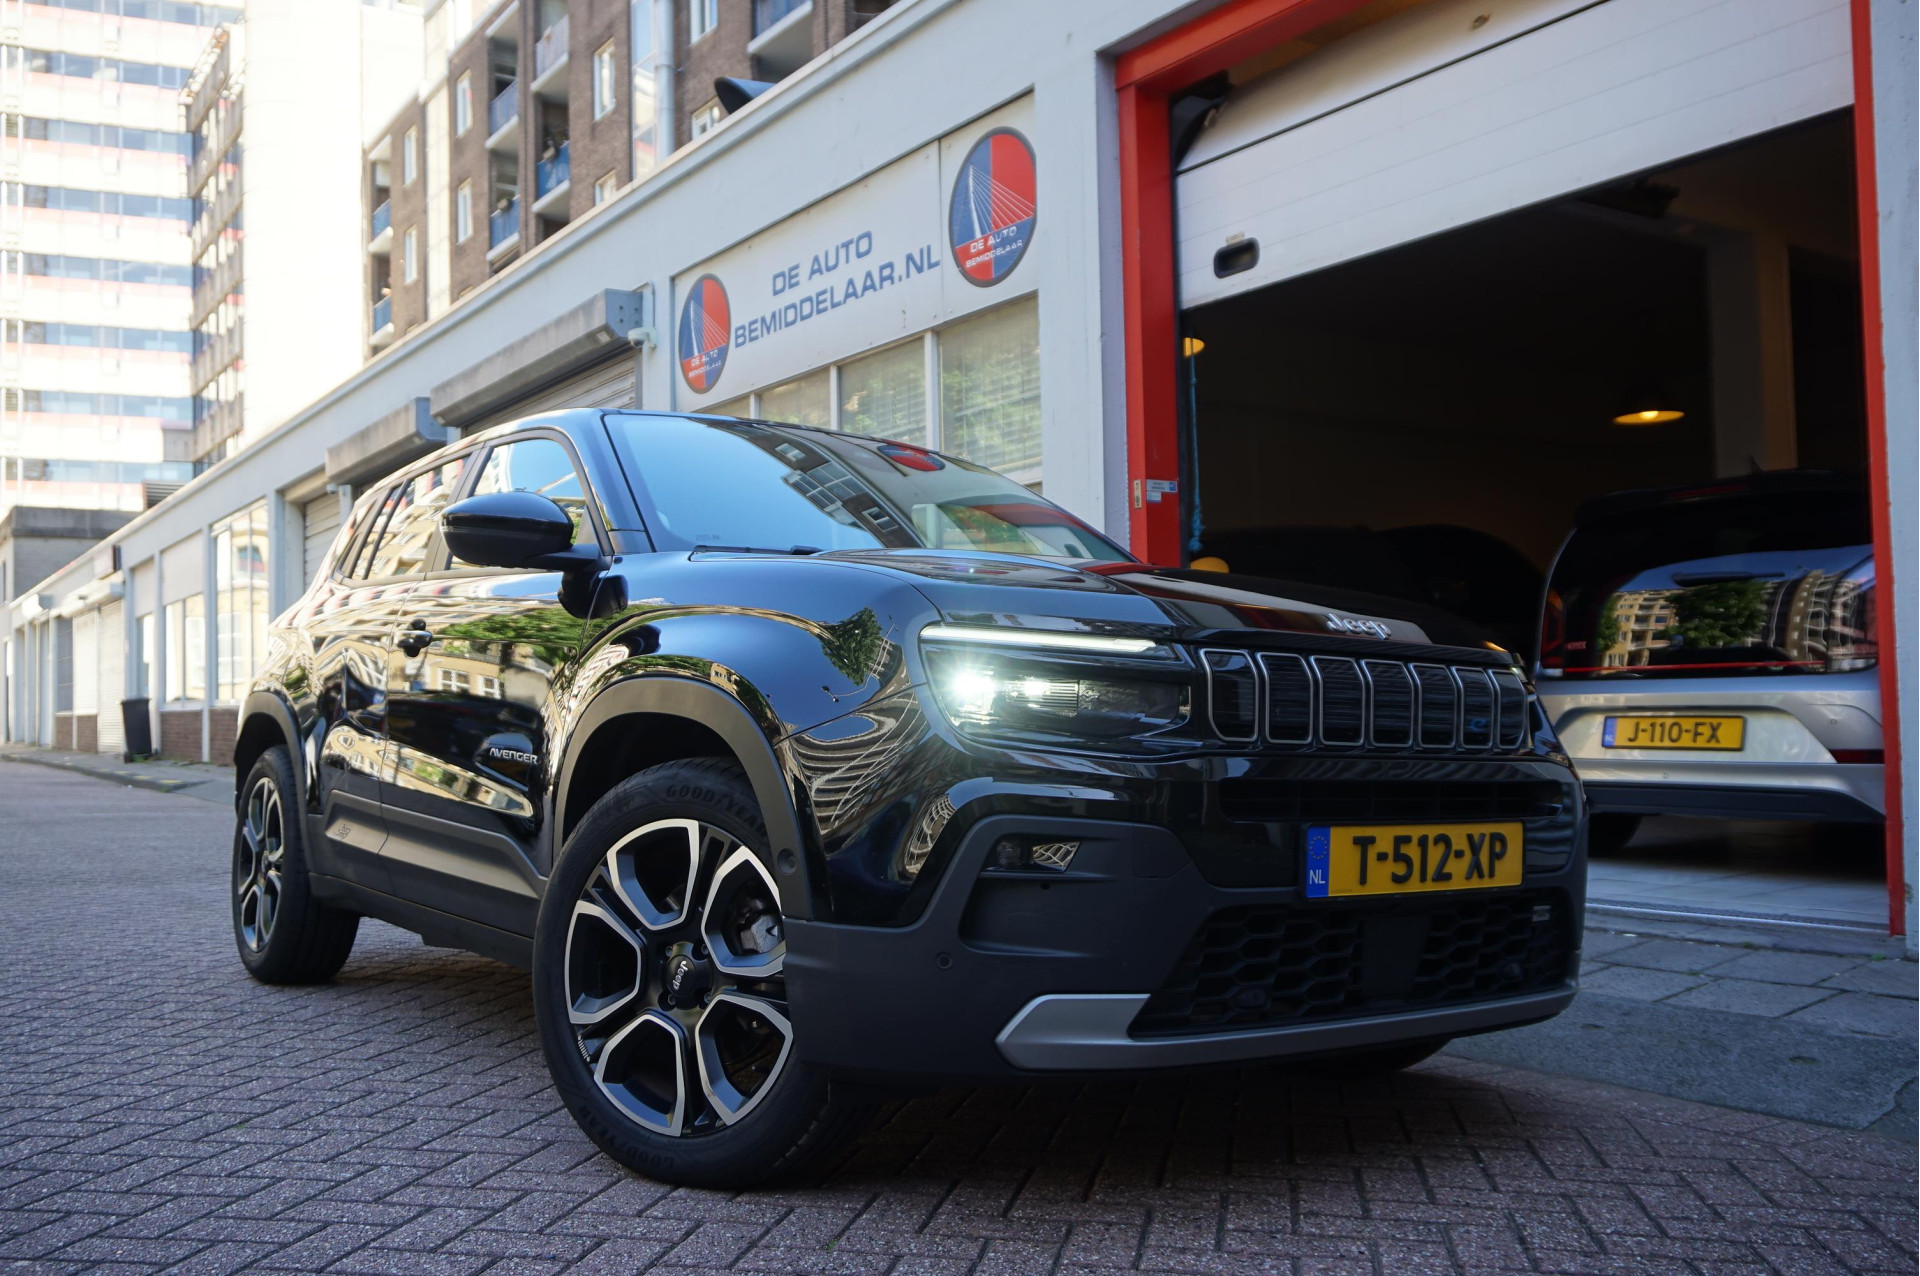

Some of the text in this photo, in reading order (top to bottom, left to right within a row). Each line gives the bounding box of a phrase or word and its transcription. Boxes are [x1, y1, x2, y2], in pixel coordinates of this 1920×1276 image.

[970, 225, 1017, 253] DE AUTO
[772, 230, 873, 297] DE AUTO
[965, 239, 1024, 268] BEMIDDELAAR
[734, 244, 941, 348] BEMIDDELAAR.NL
[1326, 613, 1392, 640] Jeep
[1627, 721, 1723, 744] J-110-FX
[489, 747, 539, 765] AVENGER
[1352, 831, 1508, 886] T-512-XP
[1309, 869, 1326, 885] NL
[672, 960, 689, 991] Jeep
